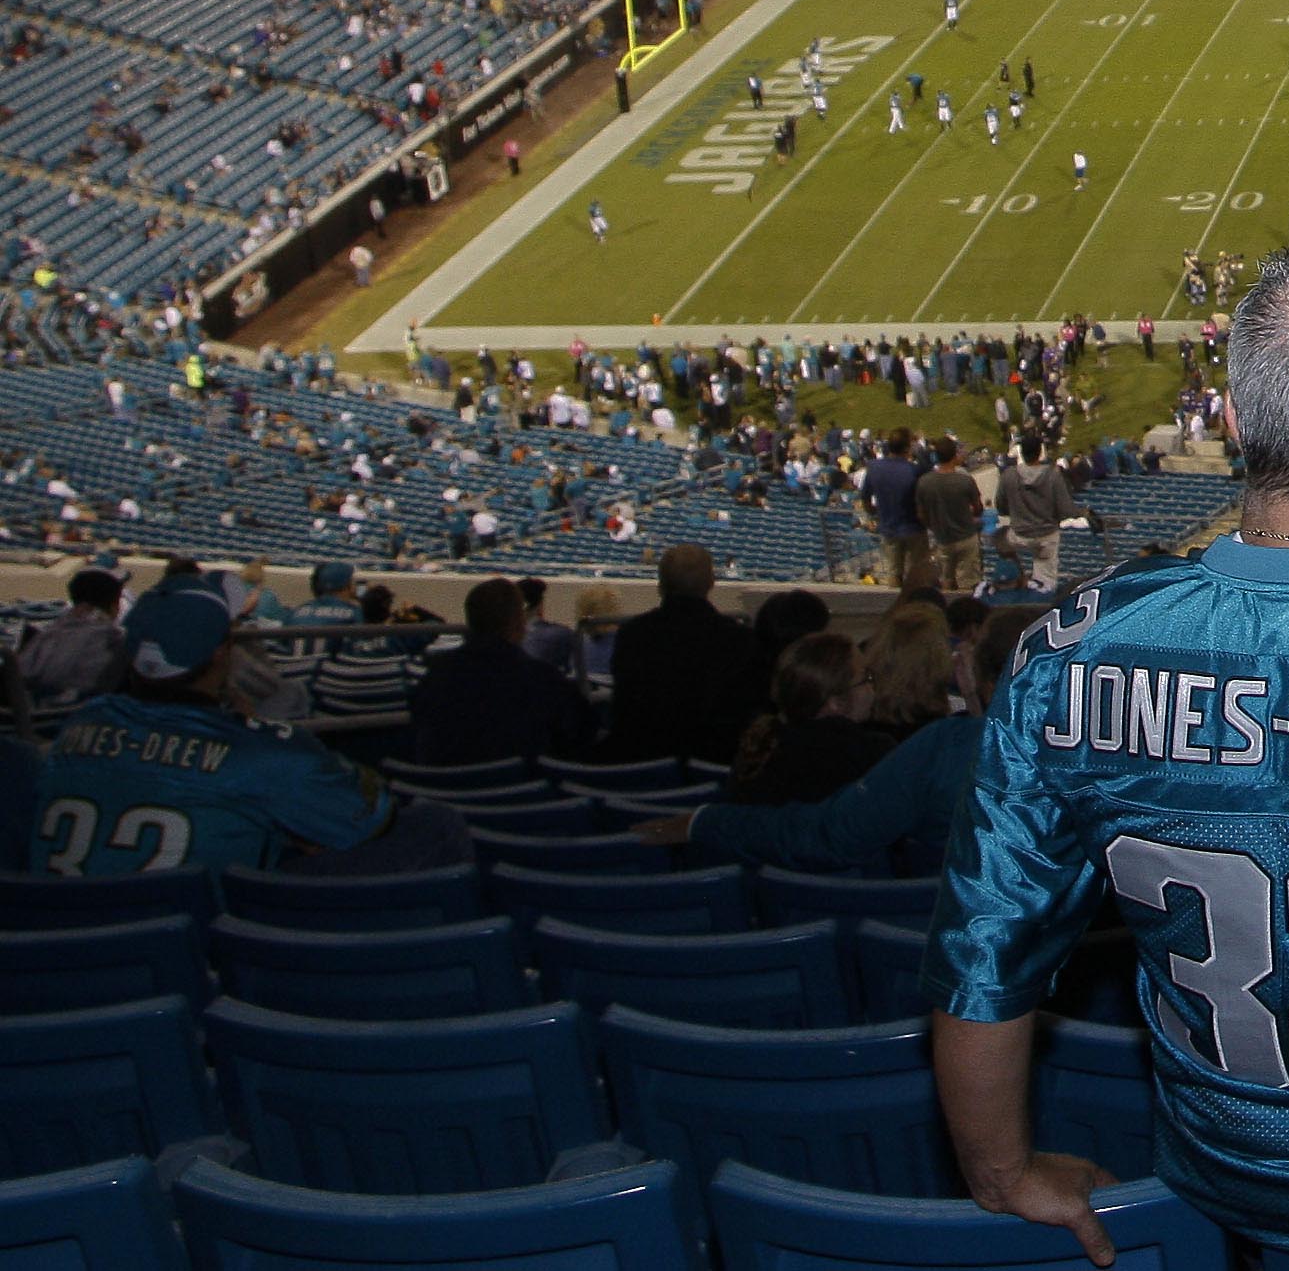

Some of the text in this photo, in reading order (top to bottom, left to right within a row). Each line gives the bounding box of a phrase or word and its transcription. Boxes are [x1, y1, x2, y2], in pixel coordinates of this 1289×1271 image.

[664, 35, 896, 195] JAGUARS
[960, 192, 1039, 215] 10
[1178, 190, 1265, 213] 20
[1011, 586, 1102, 675] 2
[40, 797, 194, 879] 32
